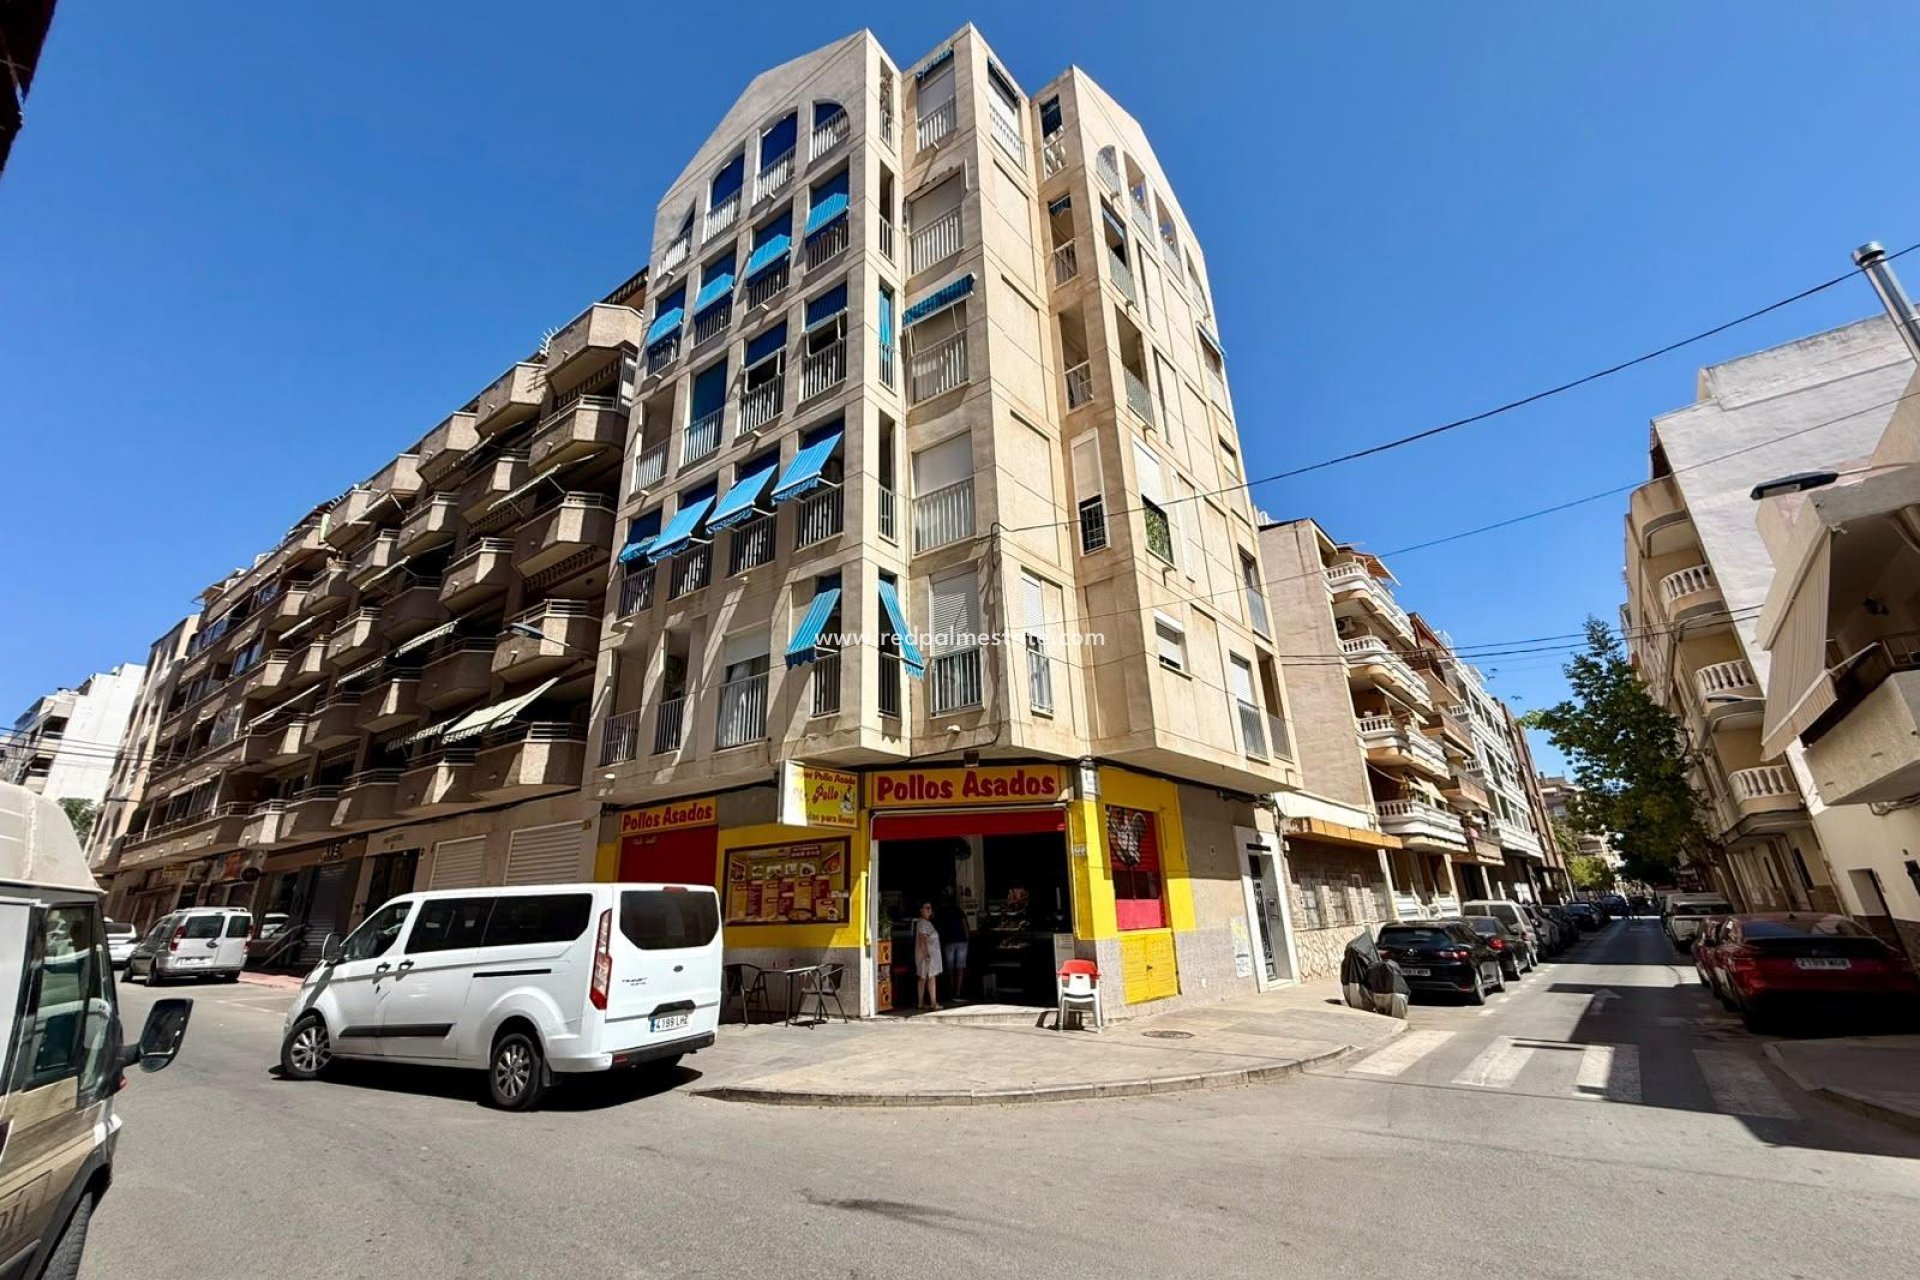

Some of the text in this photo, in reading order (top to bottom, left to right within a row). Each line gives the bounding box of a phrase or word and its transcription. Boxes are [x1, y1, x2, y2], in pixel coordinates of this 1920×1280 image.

[877, 774, 953, 801] Pollos
[962, 769, 1055, 797] Asados
[623, 803, 713, 831] Pollos Asados
